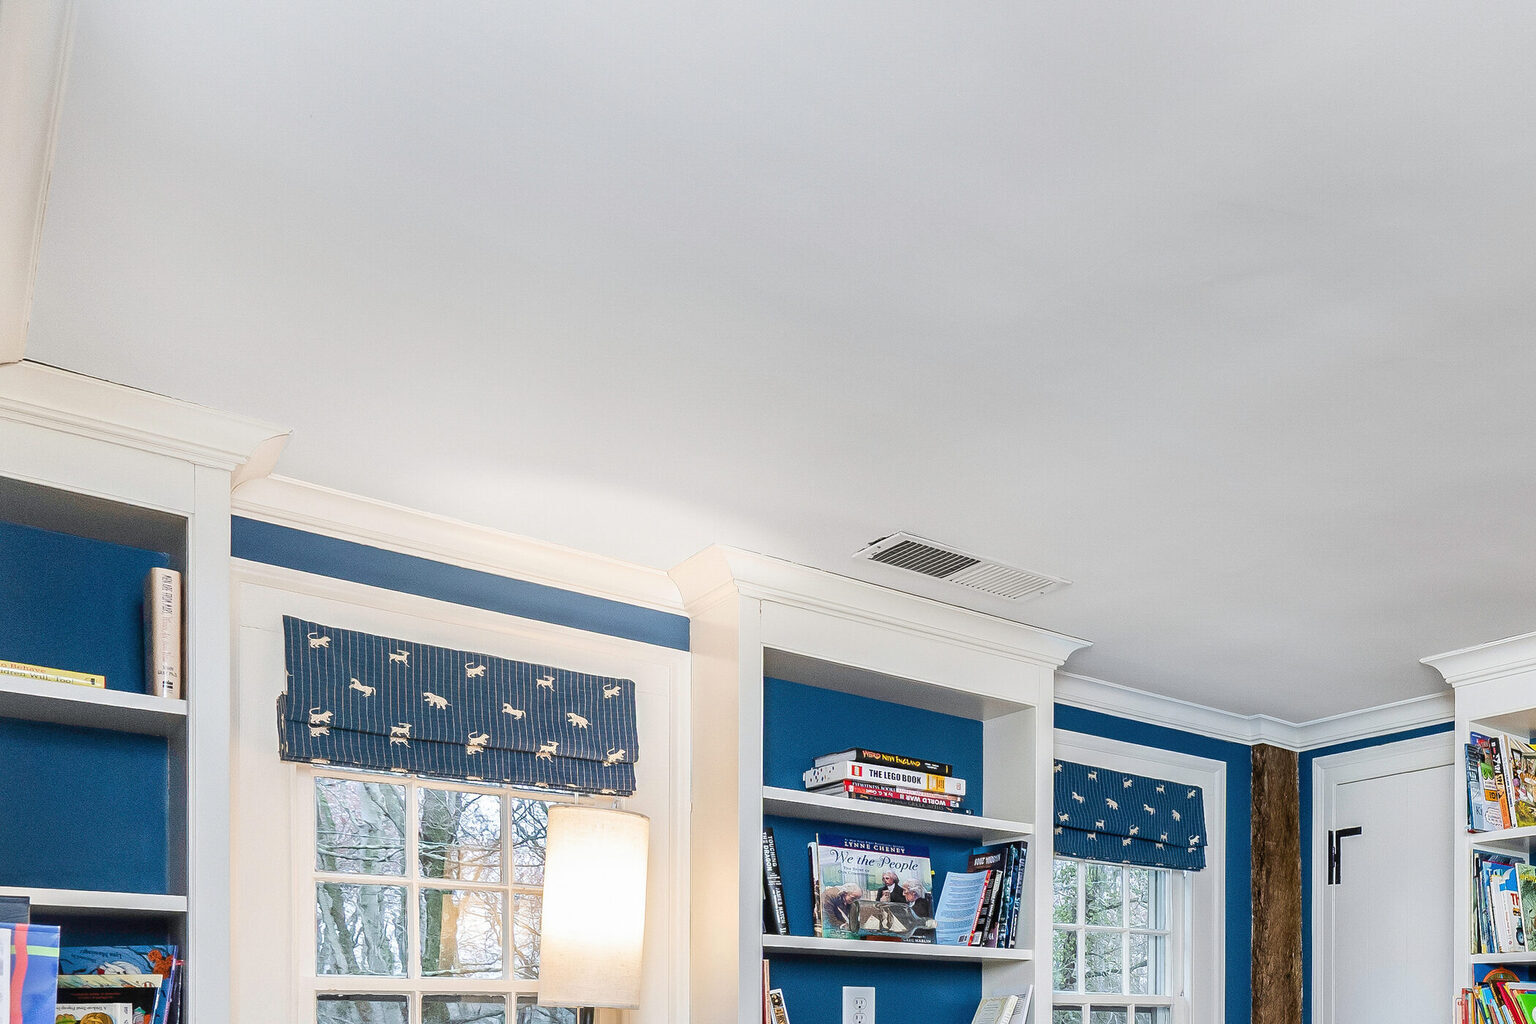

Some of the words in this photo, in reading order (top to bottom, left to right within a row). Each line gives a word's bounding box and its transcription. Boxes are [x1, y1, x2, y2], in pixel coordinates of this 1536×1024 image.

[862, 750, 881, 759] WEIRD
[896, 756, 921, 767] ENGLAND
[869, 769, 882, 778] THE
[884, 772, 900, 781] LEGO
[902, 774, 922, 784] BOOK
[922, 798, 946, 806] WORLD
[767, 835, 776, 867] TOUCHING
[844, 842, 871, 850] LYNNE
[874, 844, 905, 854] CHENEY
[763, 844, 772, 871] DRAGON
[830, 849, 854, 863] We
[857, 855, 875, 866] the
[877, 856, 918, 872] People
